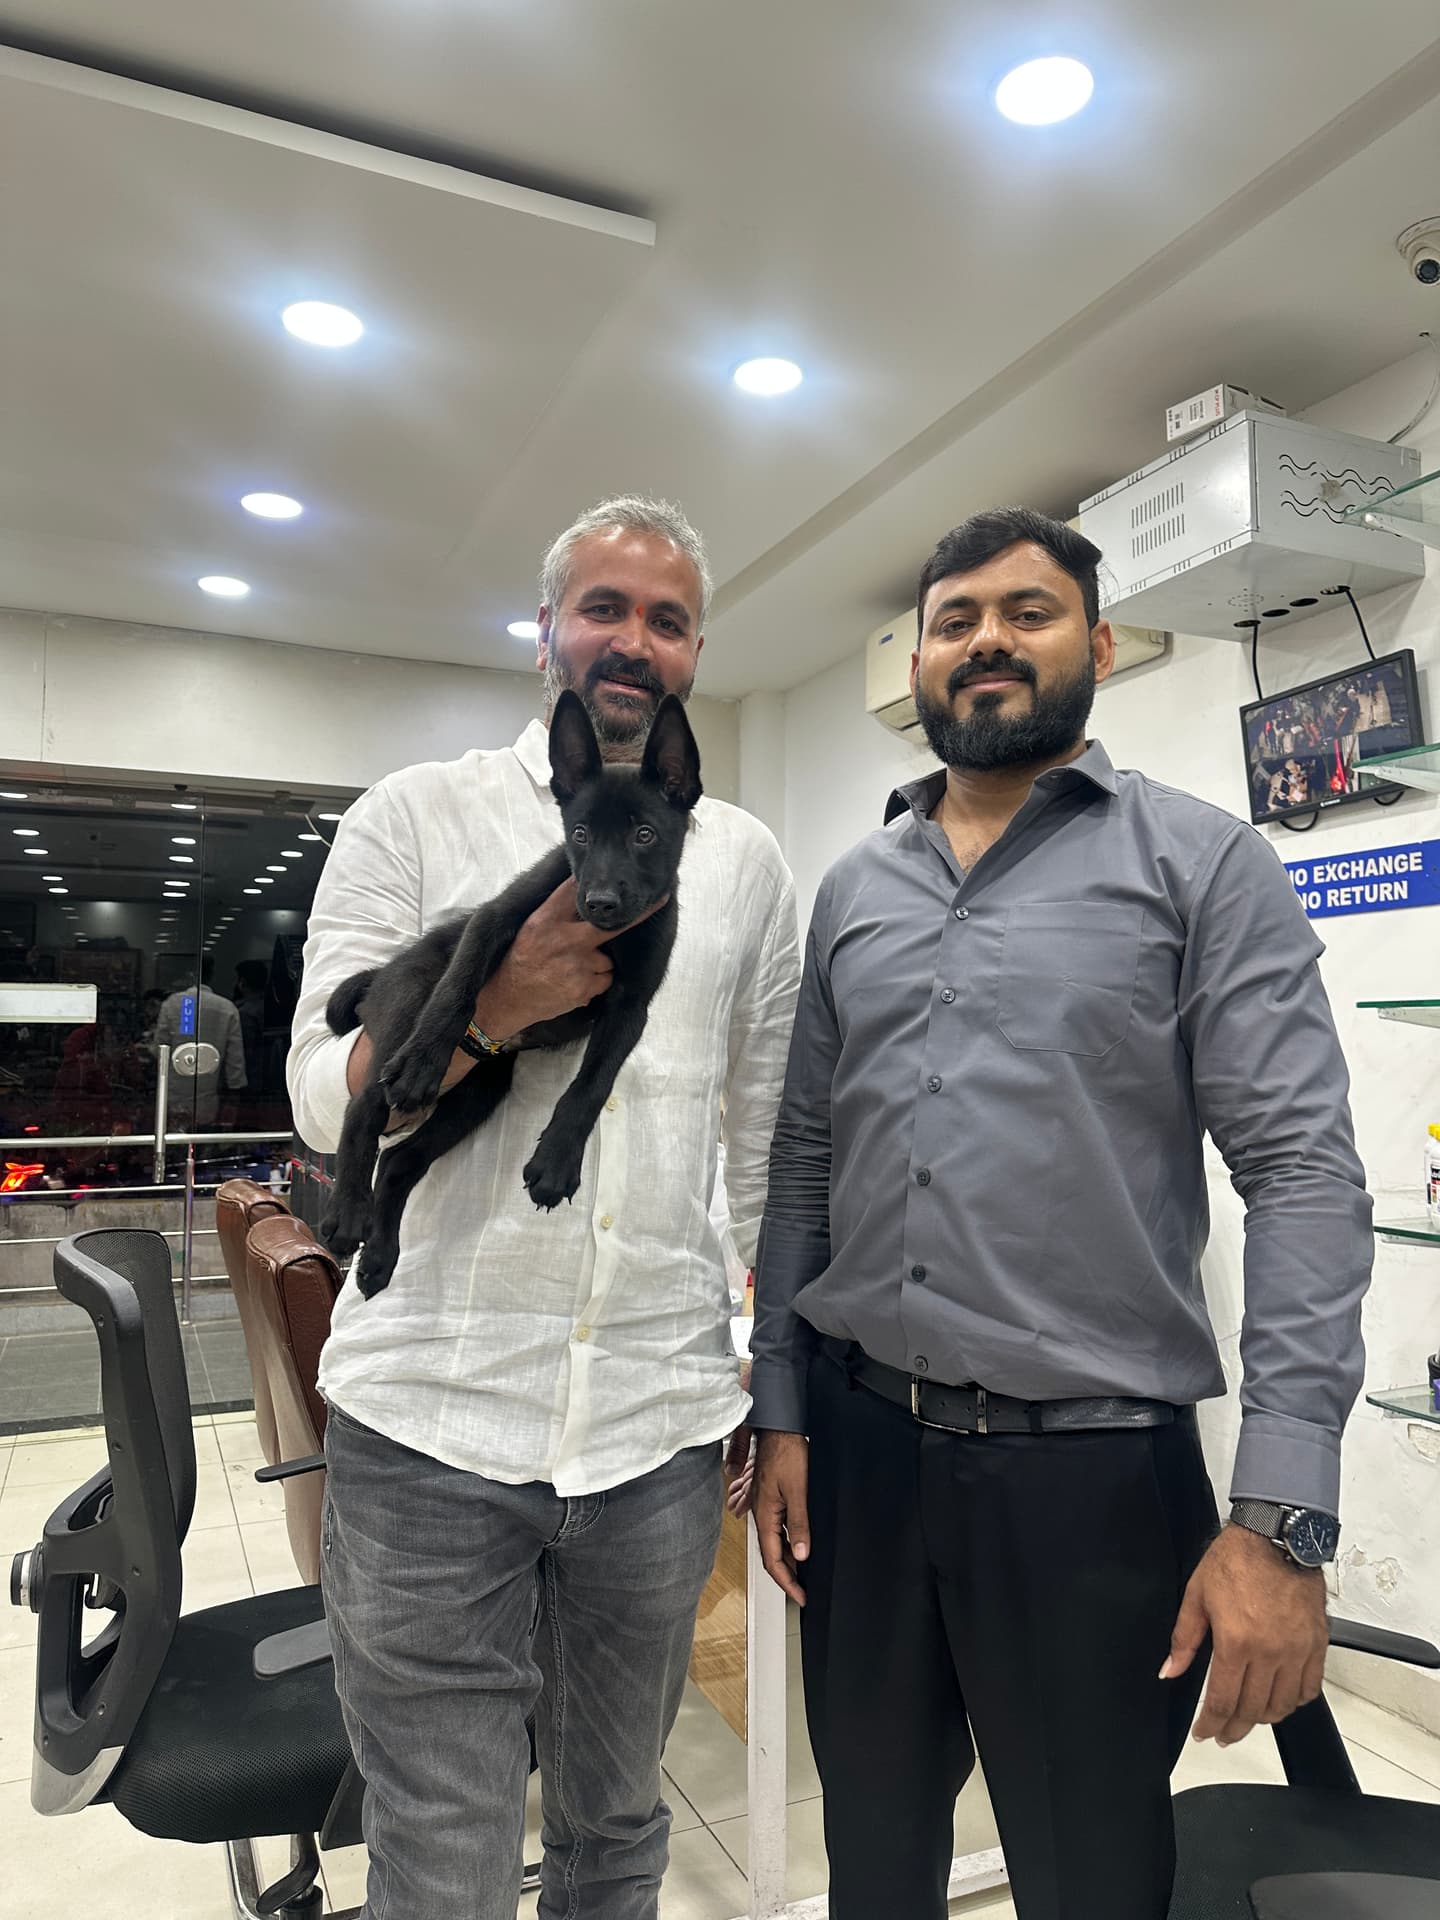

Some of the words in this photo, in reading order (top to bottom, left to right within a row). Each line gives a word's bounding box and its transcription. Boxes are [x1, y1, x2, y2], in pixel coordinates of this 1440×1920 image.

[1313, 851, 1423, 884] EXCHANGE
[1297, 891, 1321, 910] NO
[1327, 880, 1408, 907] RETURN
